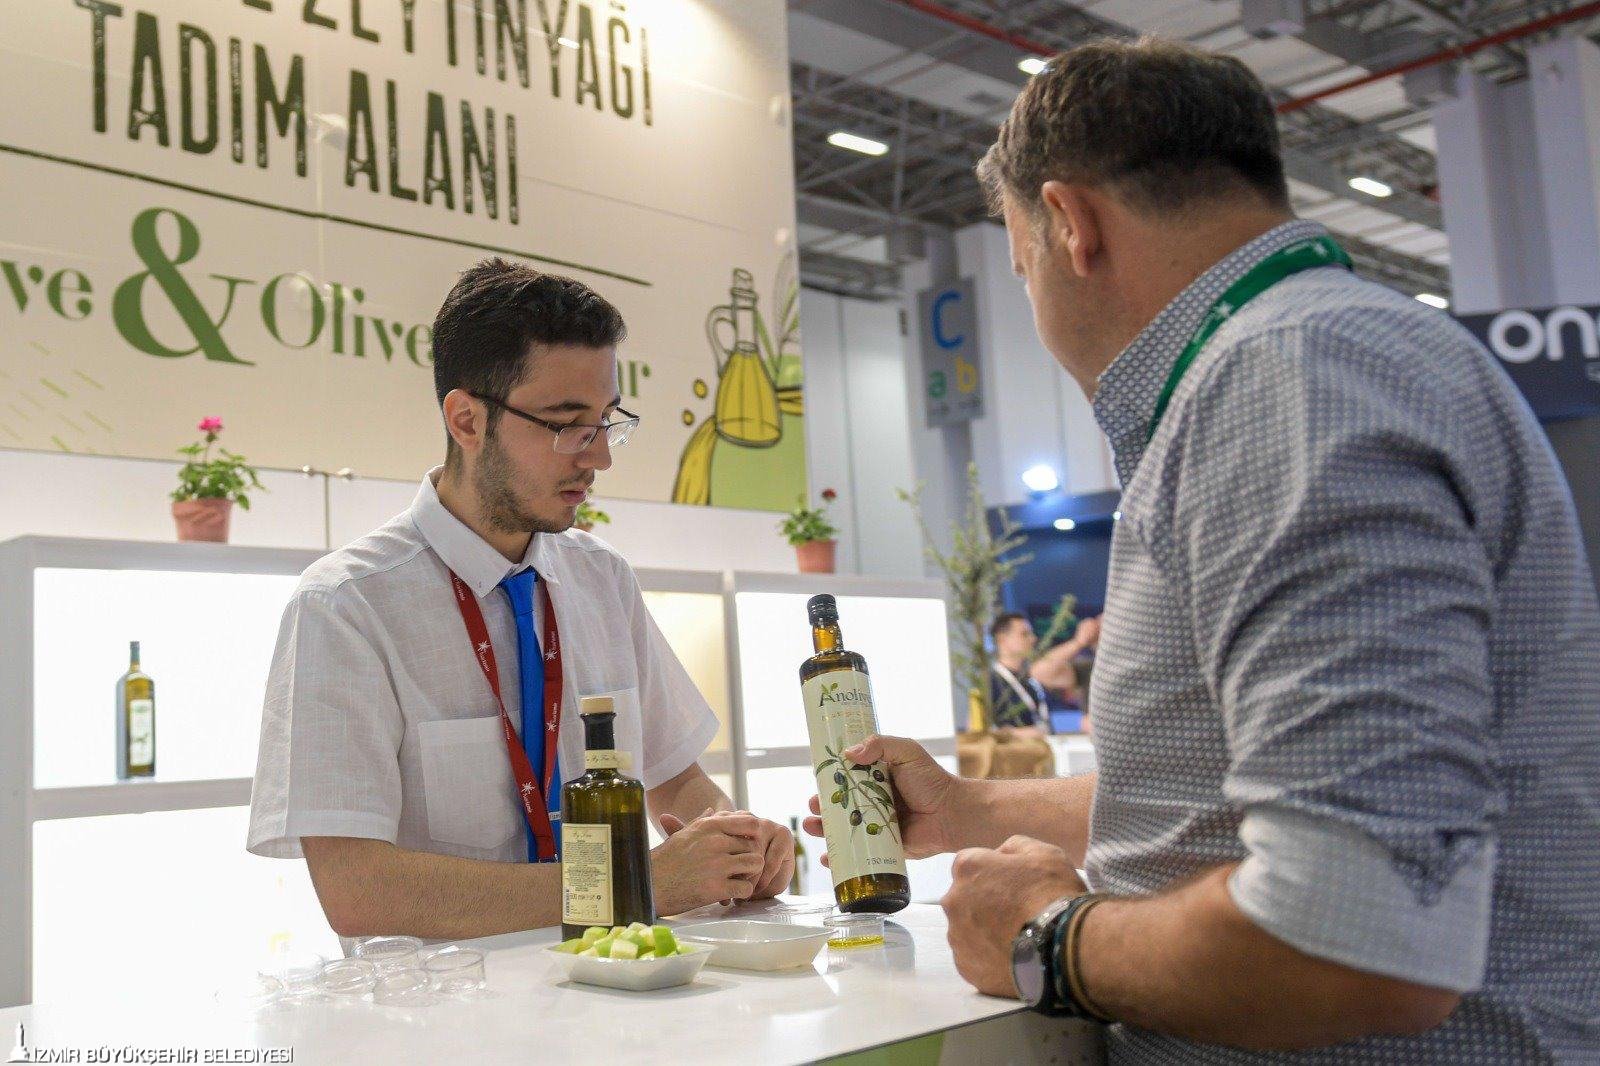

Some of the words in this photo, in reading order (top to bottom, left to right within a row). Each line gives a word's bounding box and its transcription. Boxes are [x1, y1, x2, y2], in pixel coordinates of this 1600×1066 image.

[75, 0, 308, 178] TADIM
[345, 70, 520, 225] ALANI
[112, 206, 256, 366] &
[932, 290, 964, 349] C
